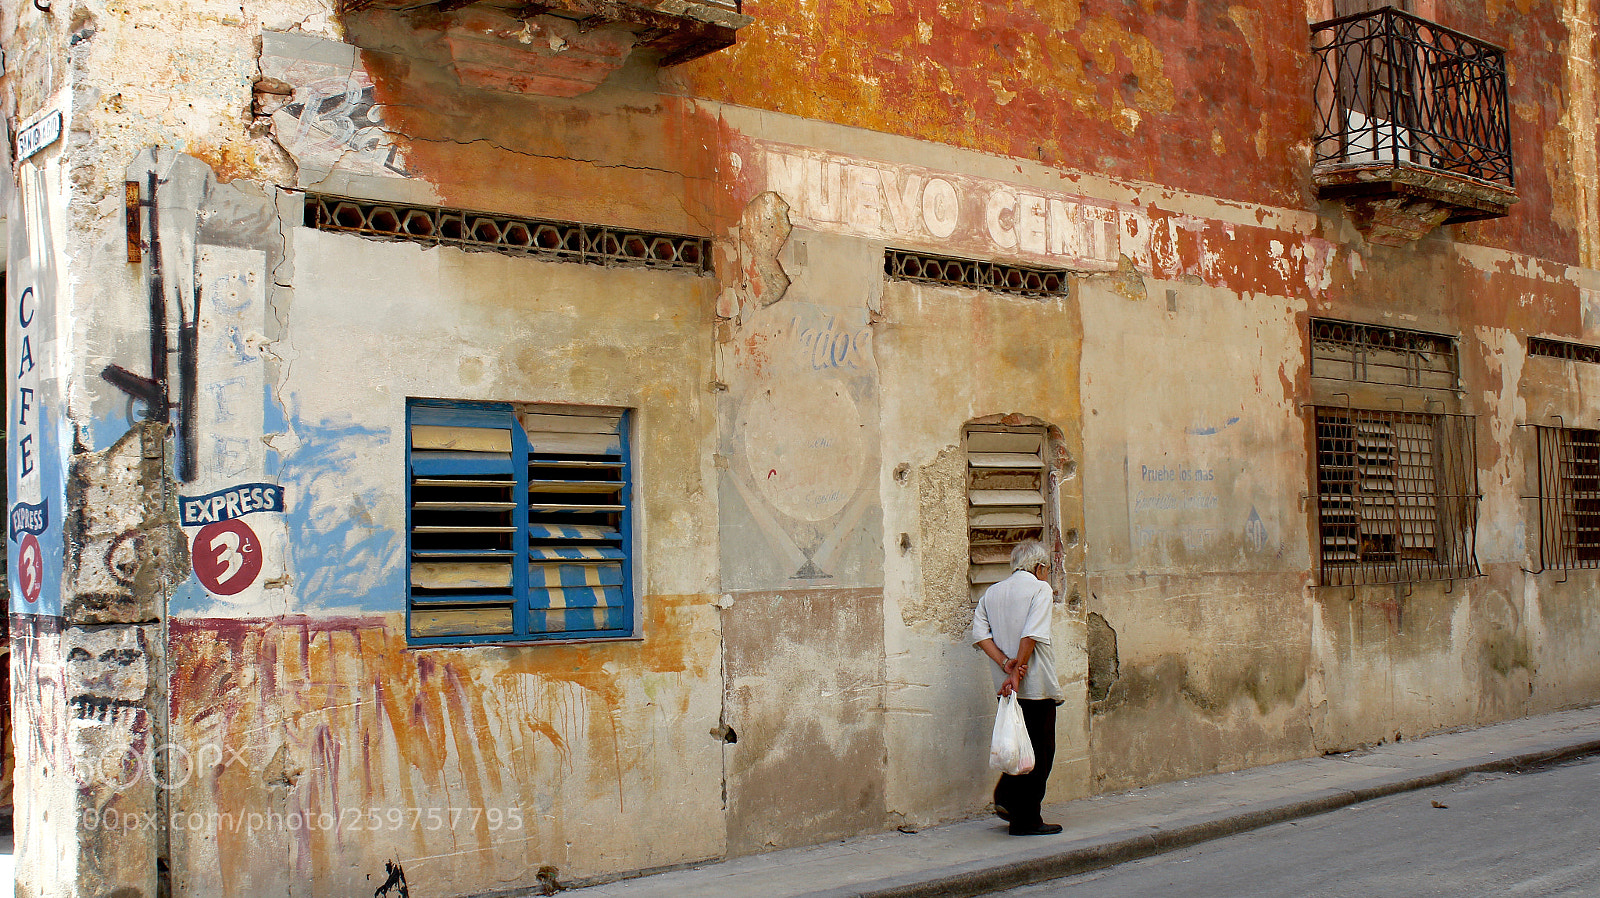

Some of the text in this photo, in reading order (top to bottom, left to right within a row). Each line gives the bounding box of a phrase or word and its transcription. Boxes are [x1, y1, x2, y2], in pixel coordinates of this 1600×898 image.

[766, 152, 960, 239] NUEVO
[18, 286, 36, 479] CAFE
[1178, 464, 1192, 481] los
[12, 507, 43, 533] EXPRESS
[185, 487, 276, 523] EXPRESS
